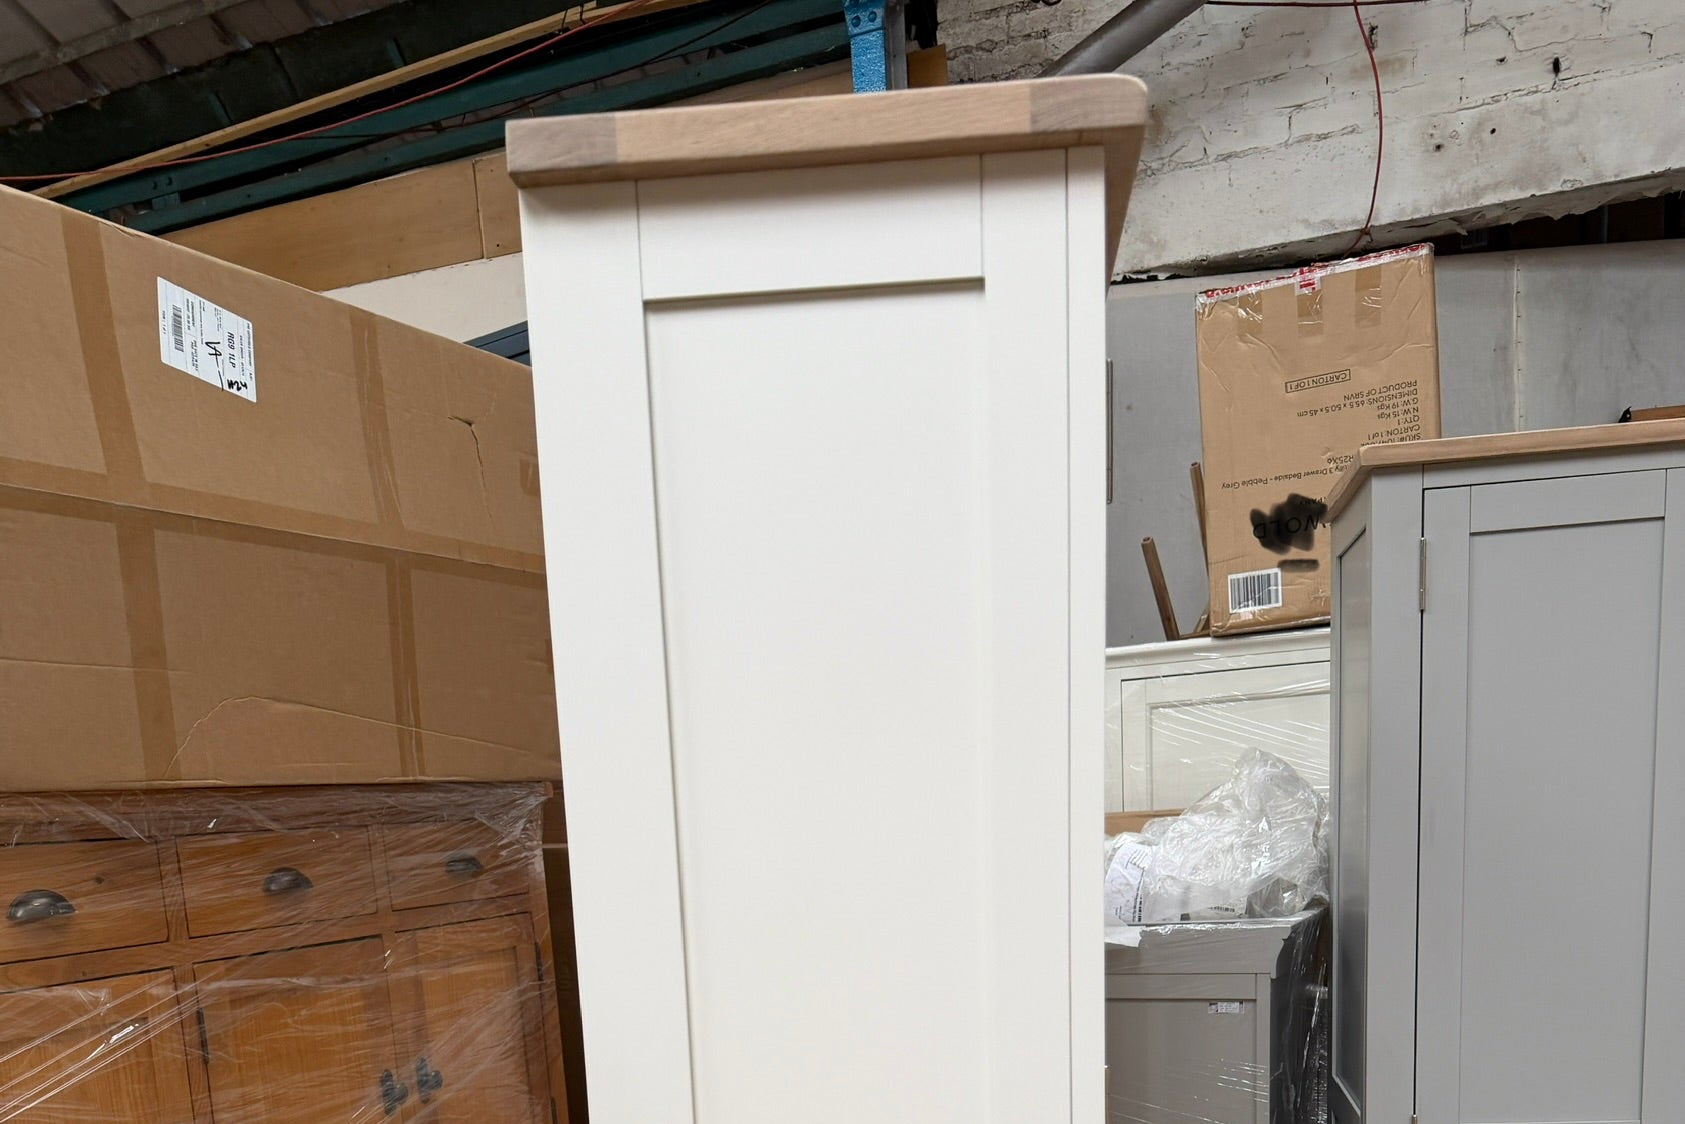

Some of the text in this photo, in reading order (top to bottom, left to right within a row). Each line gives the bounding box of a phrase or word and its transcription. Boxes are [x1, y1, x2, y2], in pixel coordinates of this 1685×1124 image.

[227, 332, 236, 368] RG9 1LP
[1311, 372, 1347, 385] CARTON
[1294, 381, 1306, 390] OF
[1343, 380, 1418, 401] PRODUCT OF SRVN
[1377, 403, 1391, 411] Kgs
[1309, 409, 1319, 417] 45
[1392, 410, 1400, 418] 15
[1401, 415, 1420, 424] QTY:
[1385, 424, 1420, 437] CARTON:
[1372, 432, 1379, 440] of
[1273, 472, 1302, 481] Bedside
[1303, 468, 1328, 477] Drawer
[1221, 481, 1240, 490] Grey
[1241, 477, 1268, 487] Pebble
